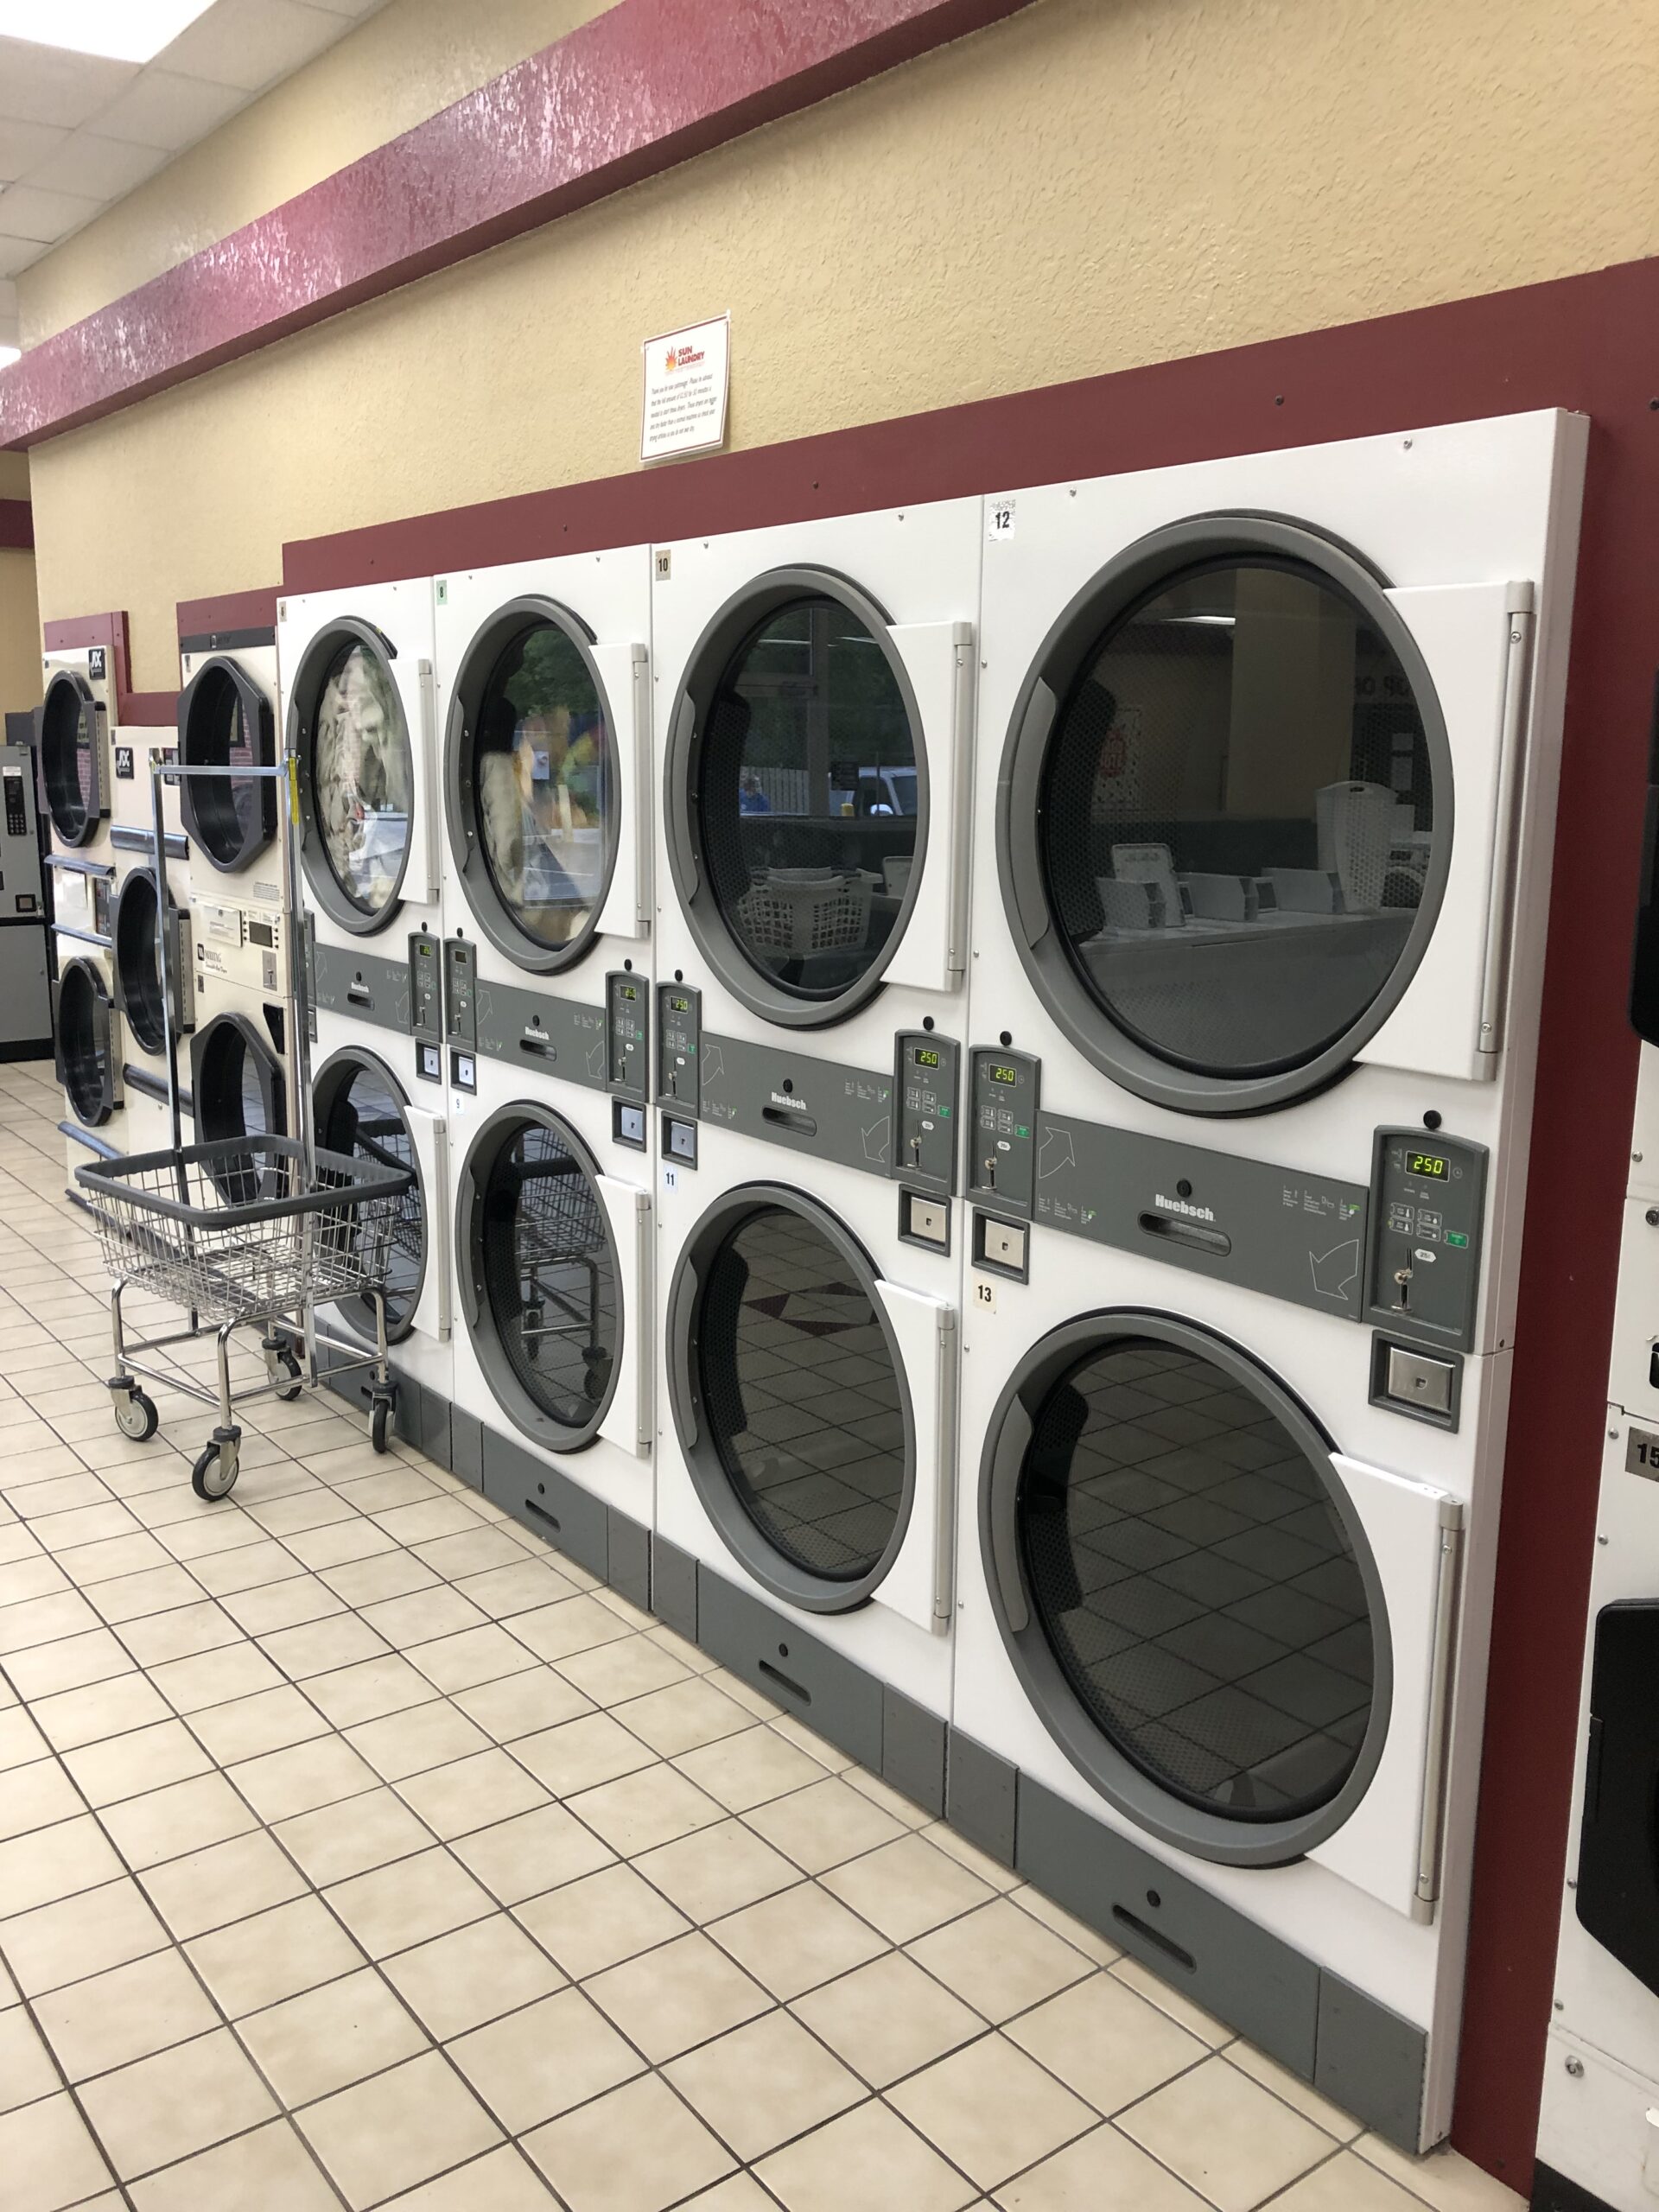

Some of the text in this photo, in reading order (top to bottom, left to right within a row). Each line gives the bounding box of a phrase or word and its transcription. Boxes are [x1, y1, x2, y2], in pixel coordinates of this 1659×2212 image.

[678, 345, 693, 357] SUN
[678, 350, 705, 366] LAUNDRY
[995, 511, 1010, 529] 12
[658, 557, 669, 572] 10
[677, 999, 688, 1010] 250
[920, 1051, 938, 1065] 250
[995, 1067, 1014, 1082] 250
[771, 1091, 807, 1110] Huebsch
[1414, 1155, 1444, 1174] 250
[665, 1172, 675, 1186] 11
[1155, 1193, 1214, 1222] Huebsch
[977, 1284, 992, 1303] 13
[1637, 1443, 1659, 1469] 15
